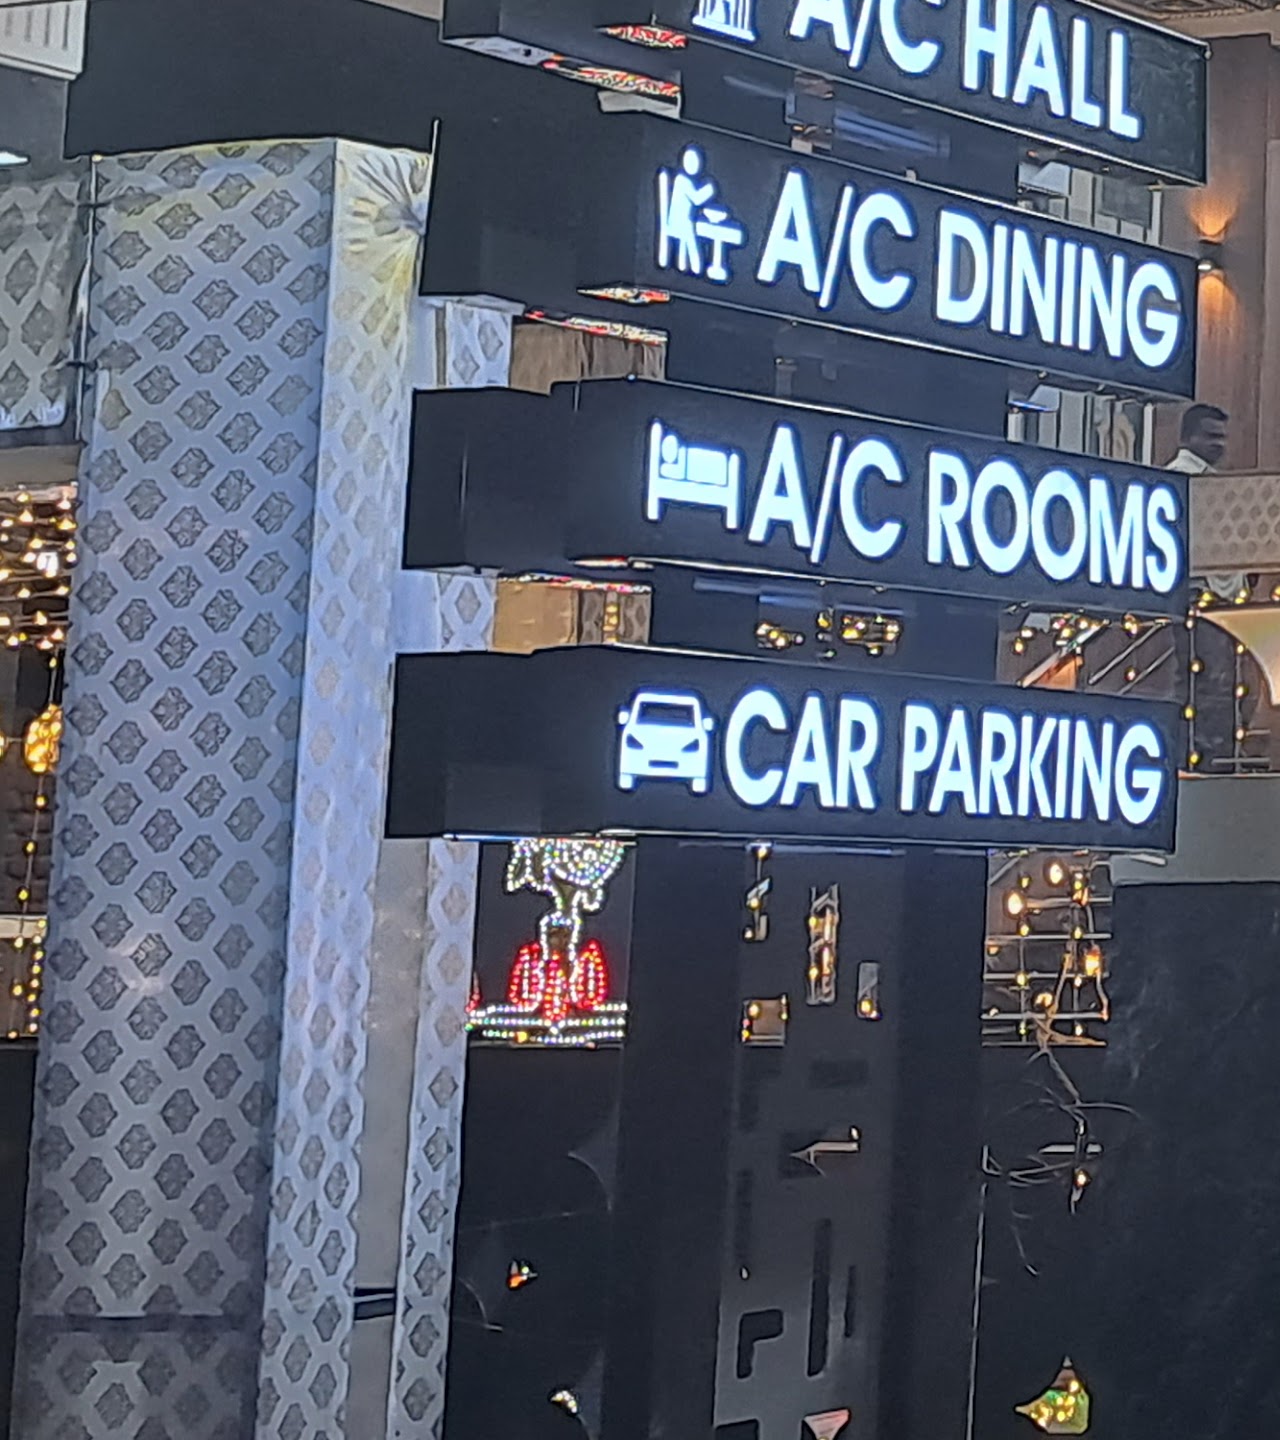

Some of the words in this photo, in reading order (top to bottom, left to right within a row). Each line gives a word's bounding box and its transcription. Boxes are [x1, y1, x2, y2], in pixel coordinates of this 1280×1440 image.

[756, 169, 914, 310] A/C
[934, 208, 1180, 369] DINING
[747, 425, 903, 565] A/C
[926, 449, 1179, 594] ROOMS
[723, 688, 880, 810] CAR
[898, 703, 1163, 826] PARKING
